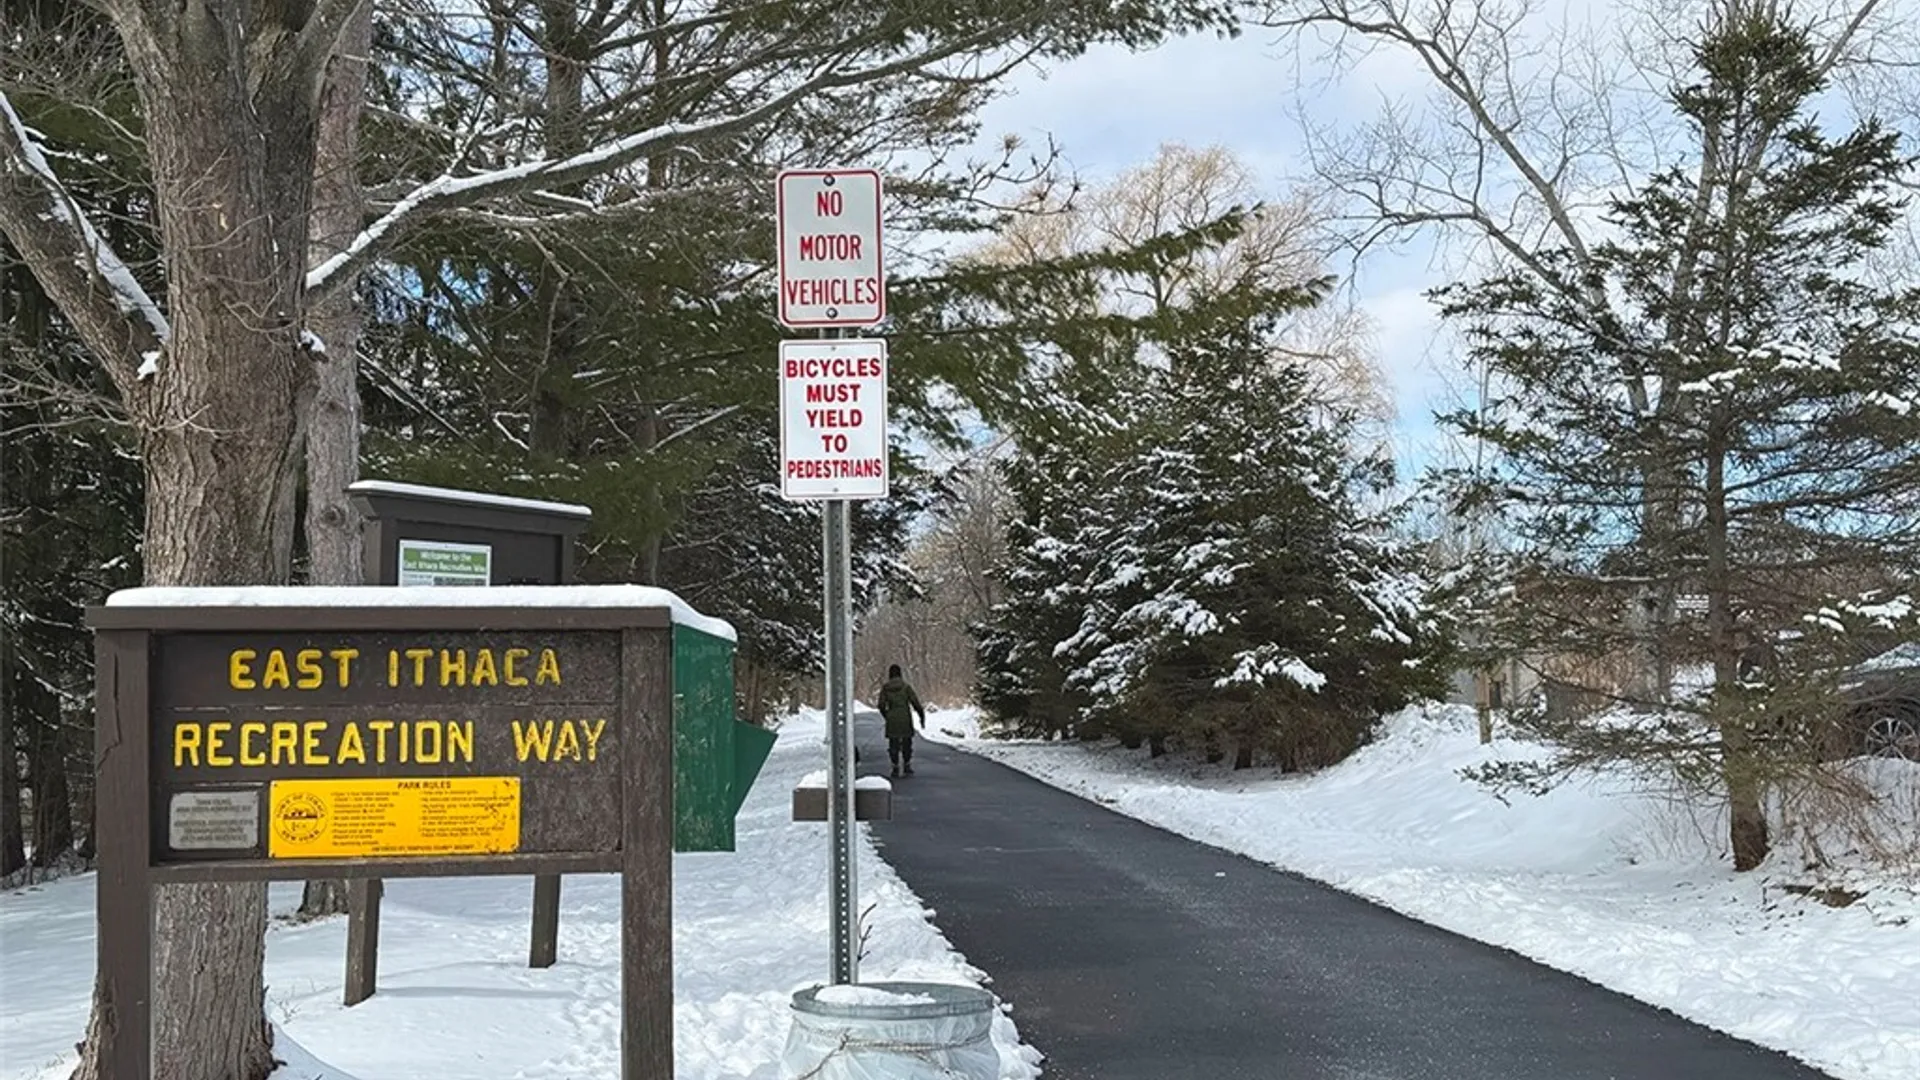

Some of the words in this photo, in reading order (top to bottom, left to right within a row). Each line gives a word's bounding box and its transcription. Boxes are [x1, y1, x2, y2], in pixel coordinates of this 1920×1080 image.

[816, 190, 842, 217] NO
[800, 234, 862, 261] MOTOR
[786, 277, 877, 305] VEHICLES
[786, 358, 881, 378] BICYCLES
[806, 384, 861, 402] MUST
[806, 409, 863, 428] YIELD
[821, 434, 848, 453] TO
[788, 459, 882, 478] PEDESTRIANS
[229, 648, 359, 689] EAST
[388, 648, 562, 688] ITHACA
[173, 719, 475, 767] RECREATION
[511, 719, 607, 763] WAY
[397, 781, 420, 789] PARK
[422, 781, 451, 789] RULES
